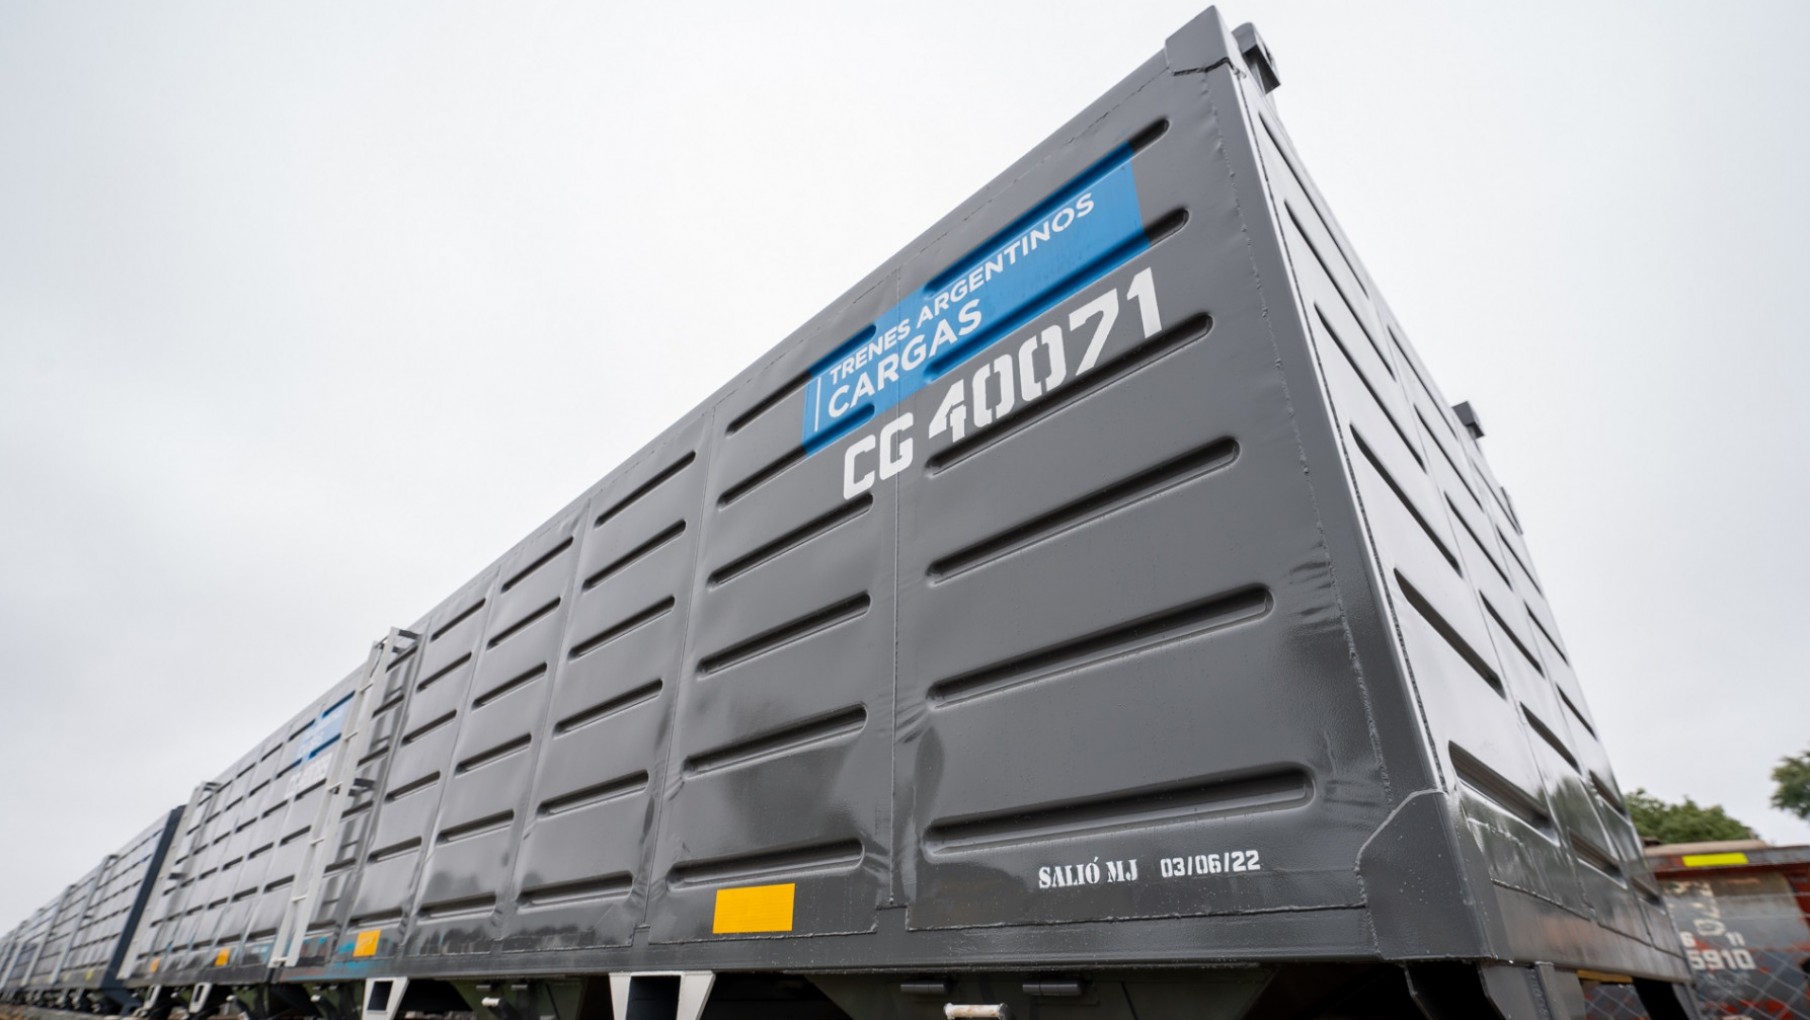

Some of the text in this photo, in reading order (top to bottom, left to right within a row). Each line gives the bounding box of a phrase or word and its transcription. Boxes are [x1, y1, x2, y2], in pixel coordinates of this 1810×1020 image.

[829, 192, 1095, 384] TRENES ARGENTINOS
[828, 299, 983, 418] CARGAS
[843, 267, 1163, 500] CG 40071
[1038, 850, 1261, 889] SALIÓ MJ 03/06/22
[1688, 948, 1757, 970] 5910
